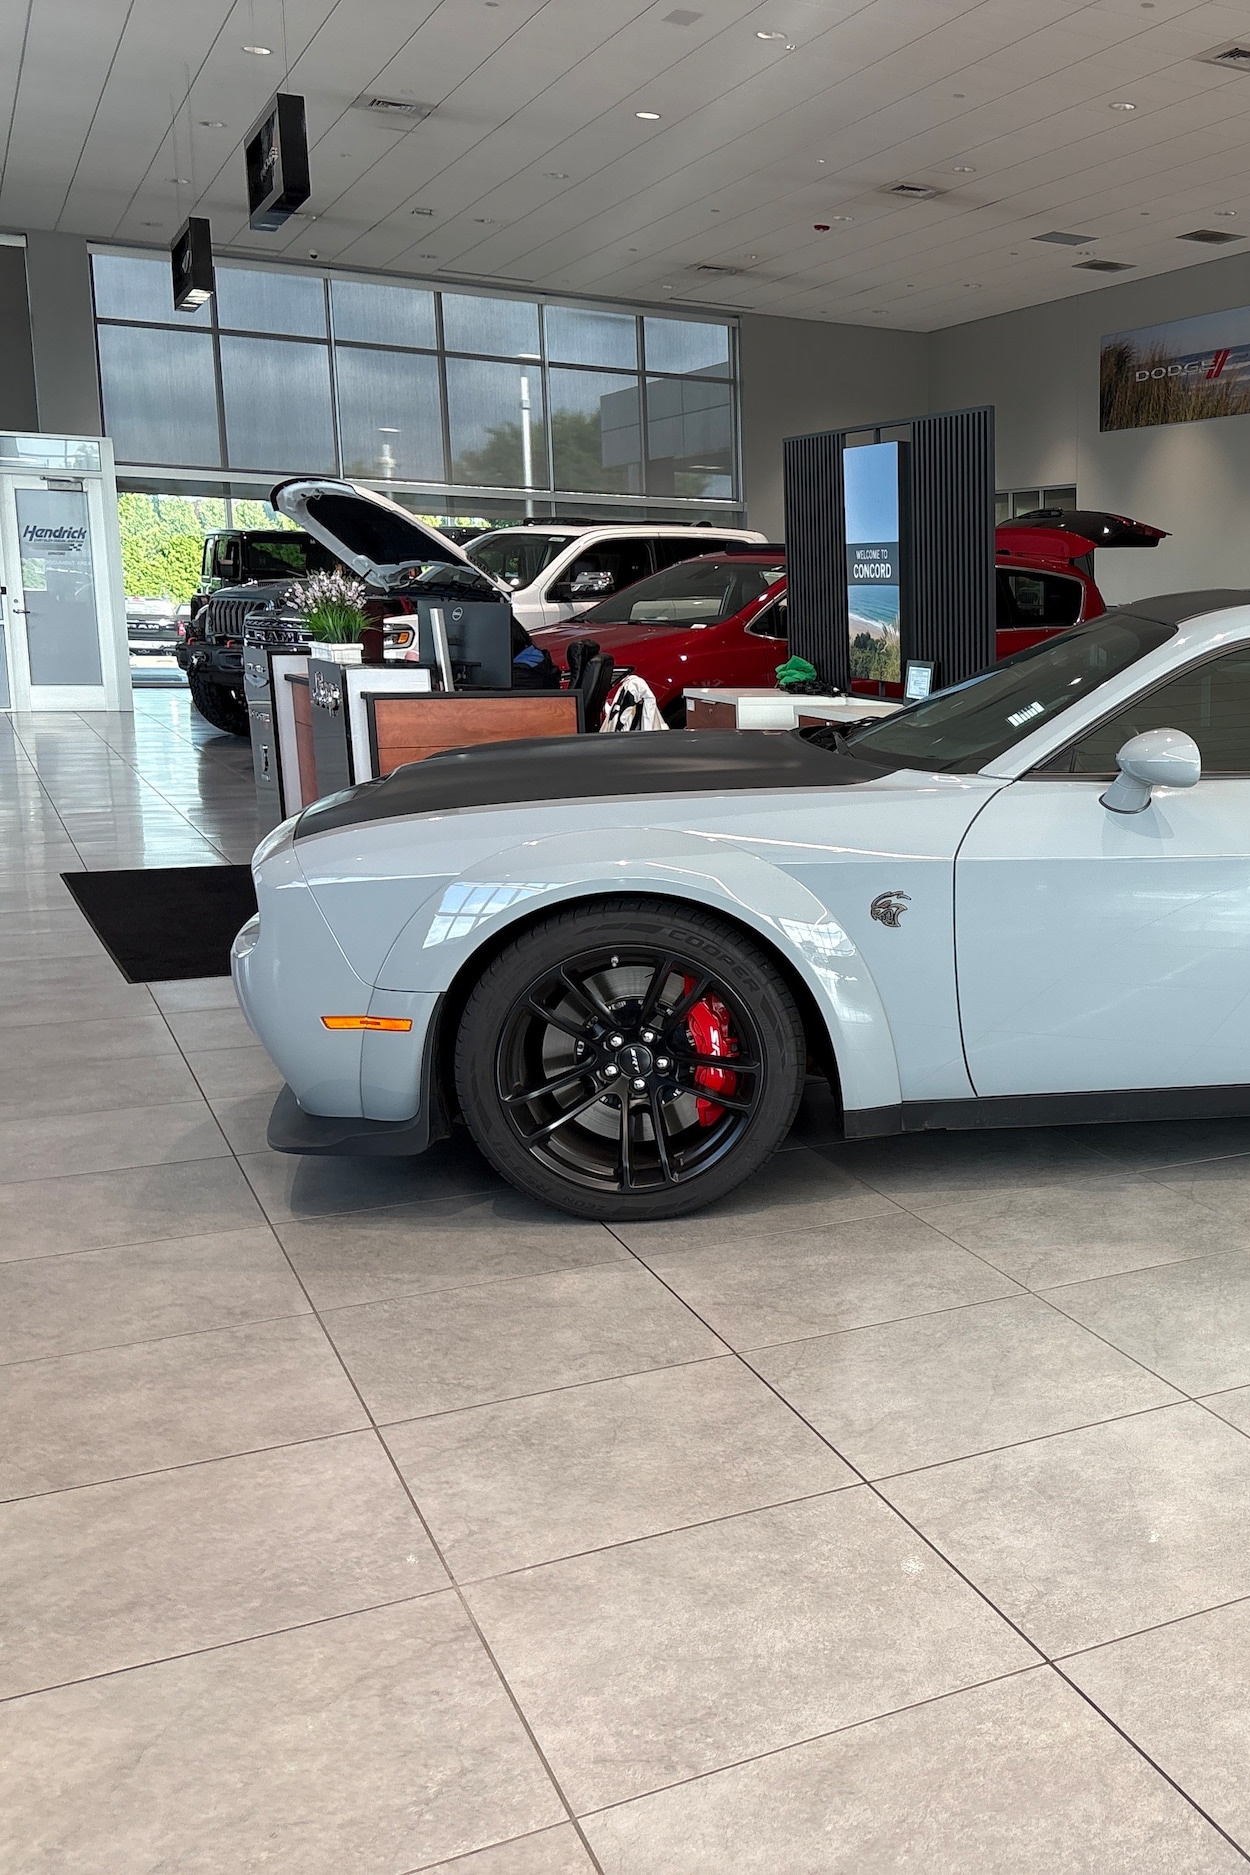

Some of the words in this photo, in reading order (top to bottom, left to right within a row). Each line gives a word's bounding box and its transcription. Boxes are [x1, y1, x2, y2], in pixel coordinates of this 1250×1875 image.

[1135, 359, 1216, 383] DODGE
[22, 525, 87, 541] Hendrick
[855, 549, 880, 560] WELCOME
[880, 548, 888, 560] TO
[853, 563, 892, 579] CONCORD
[253, 630, 295, 643] RAM
[668, 930, 760, 994] COOPER
